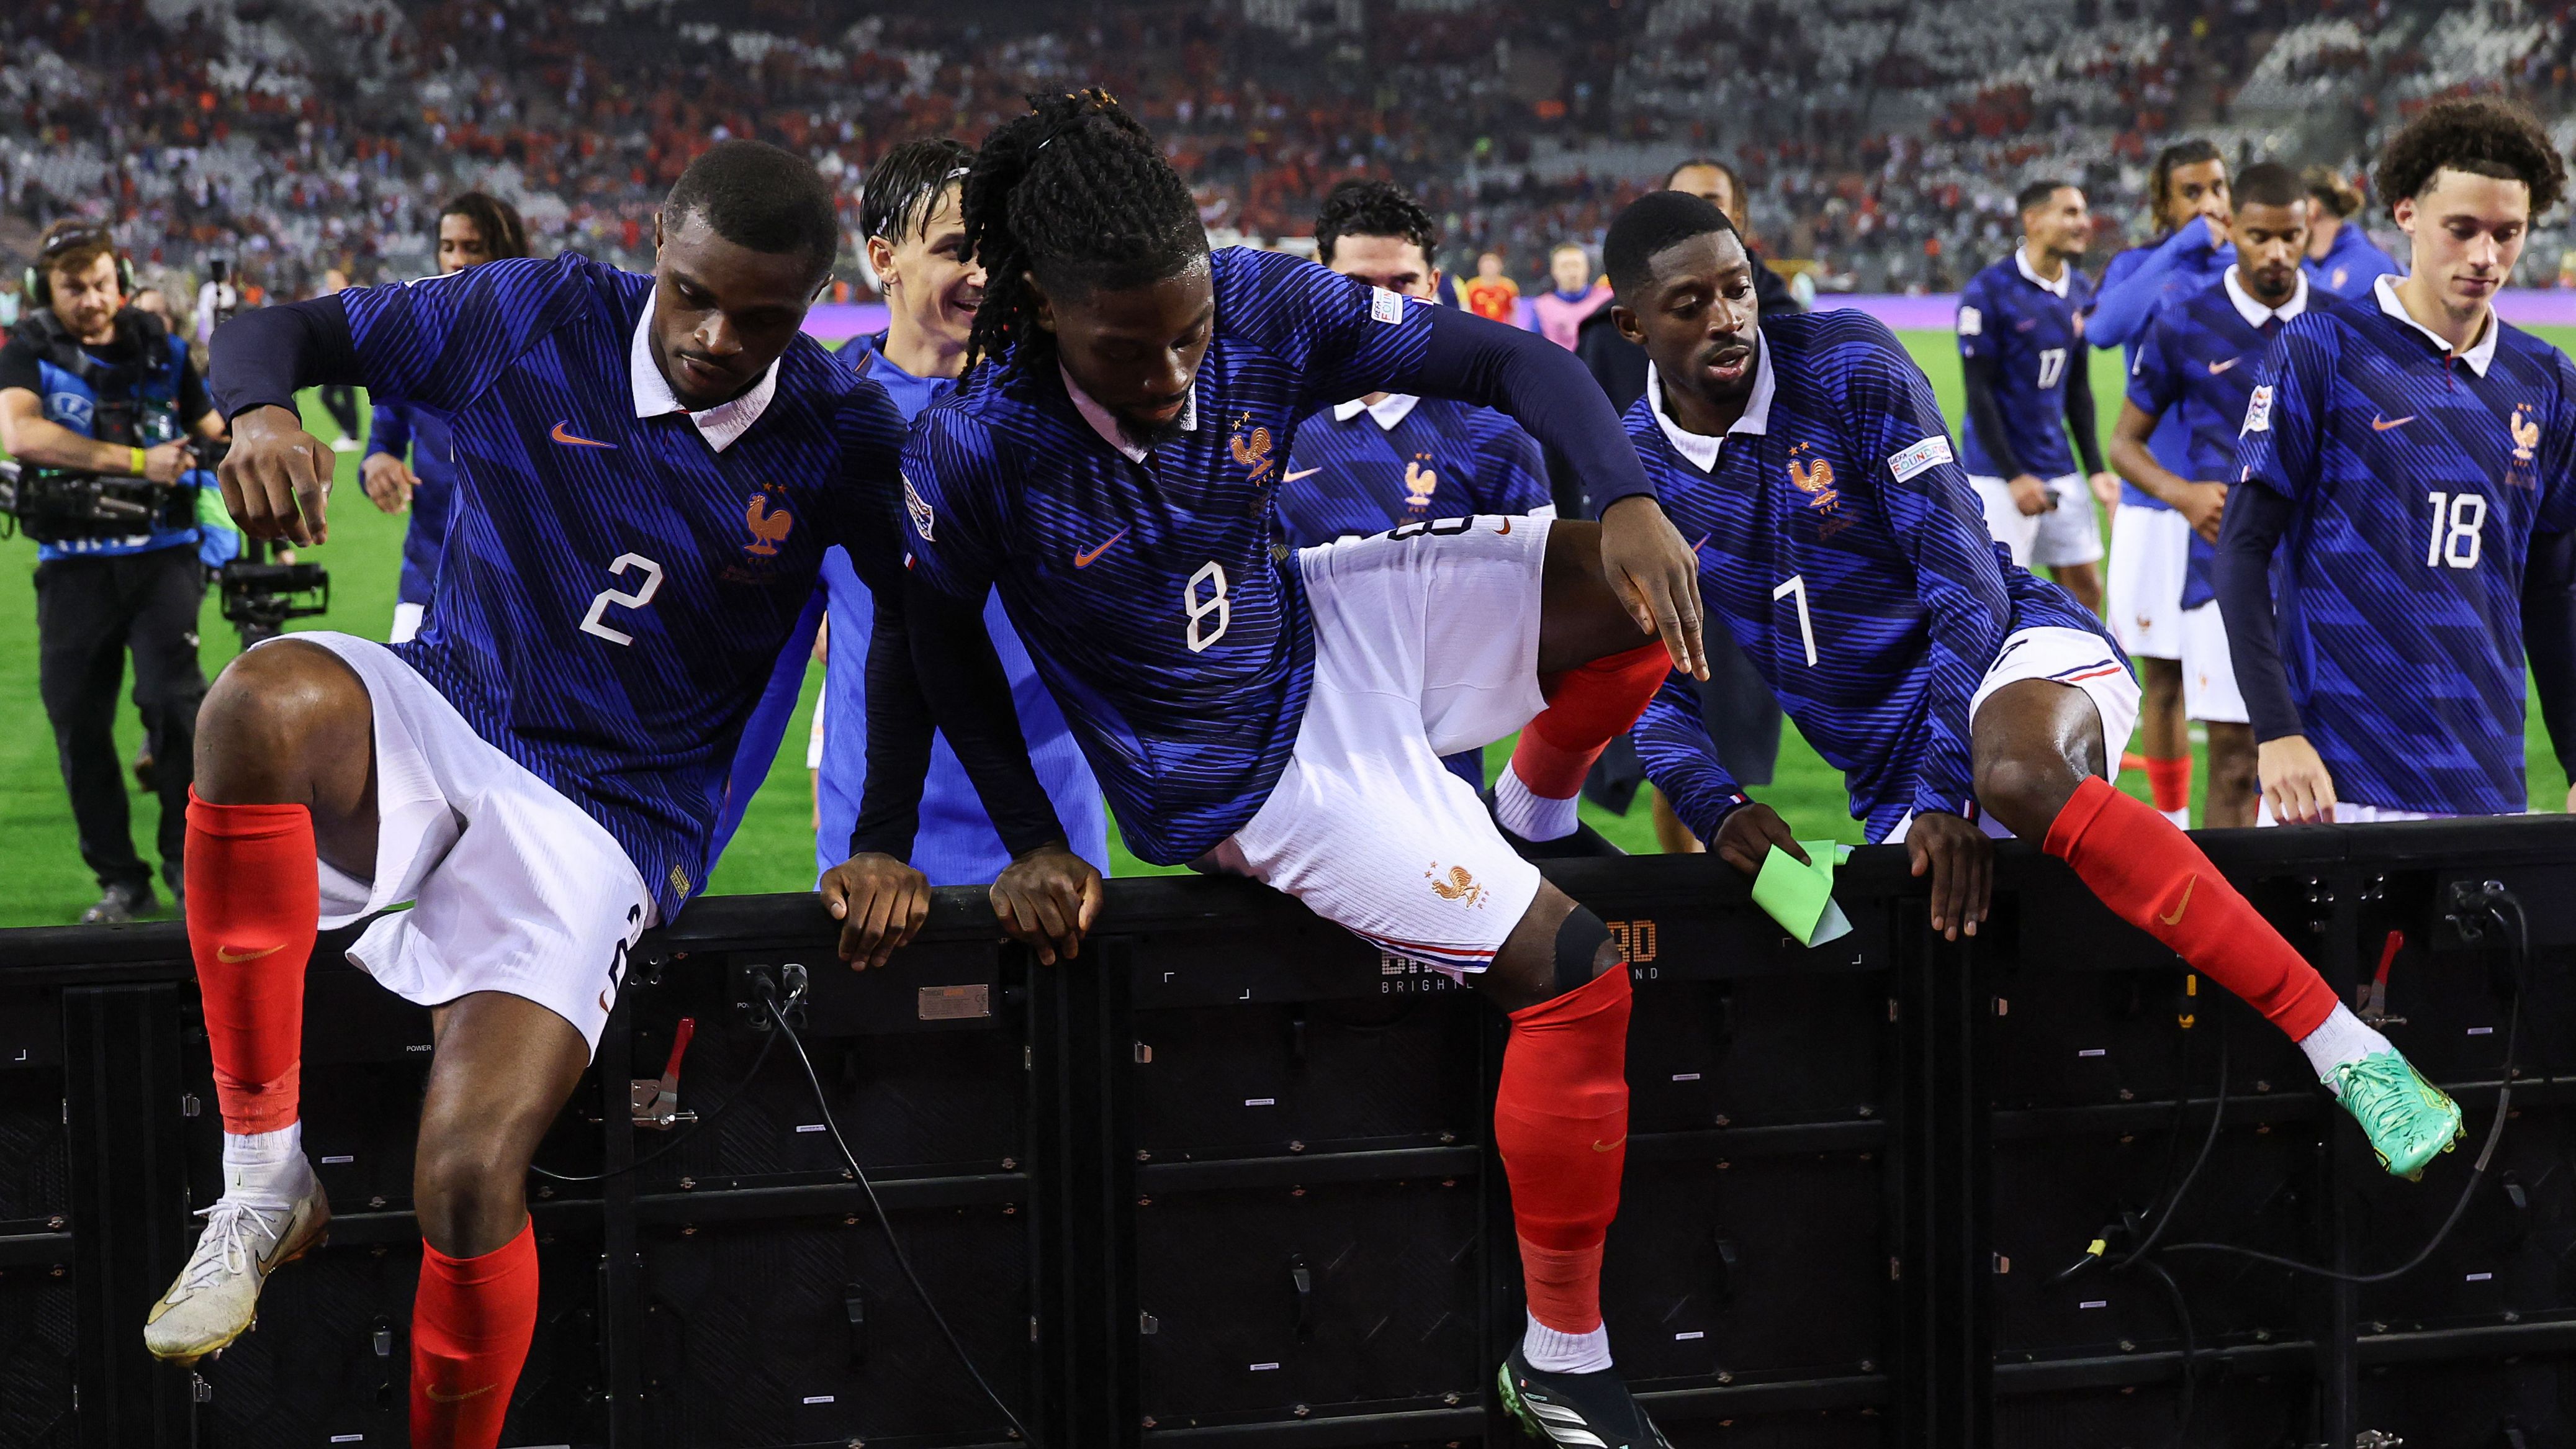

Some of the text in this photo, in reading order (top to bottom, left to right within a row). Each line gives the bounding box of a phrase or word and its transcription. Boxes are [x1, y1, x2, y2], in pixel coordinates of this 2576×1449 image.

[2038, 348, 2067, 389] 17
[1889, 453, 1907, 465] UEFA
[2428, 491, 2487, 569] 18
[579, 552, 664, 646] 2
[1184, 560, 1230, 653] 8
[1773, 574, 1818, 667] 7
